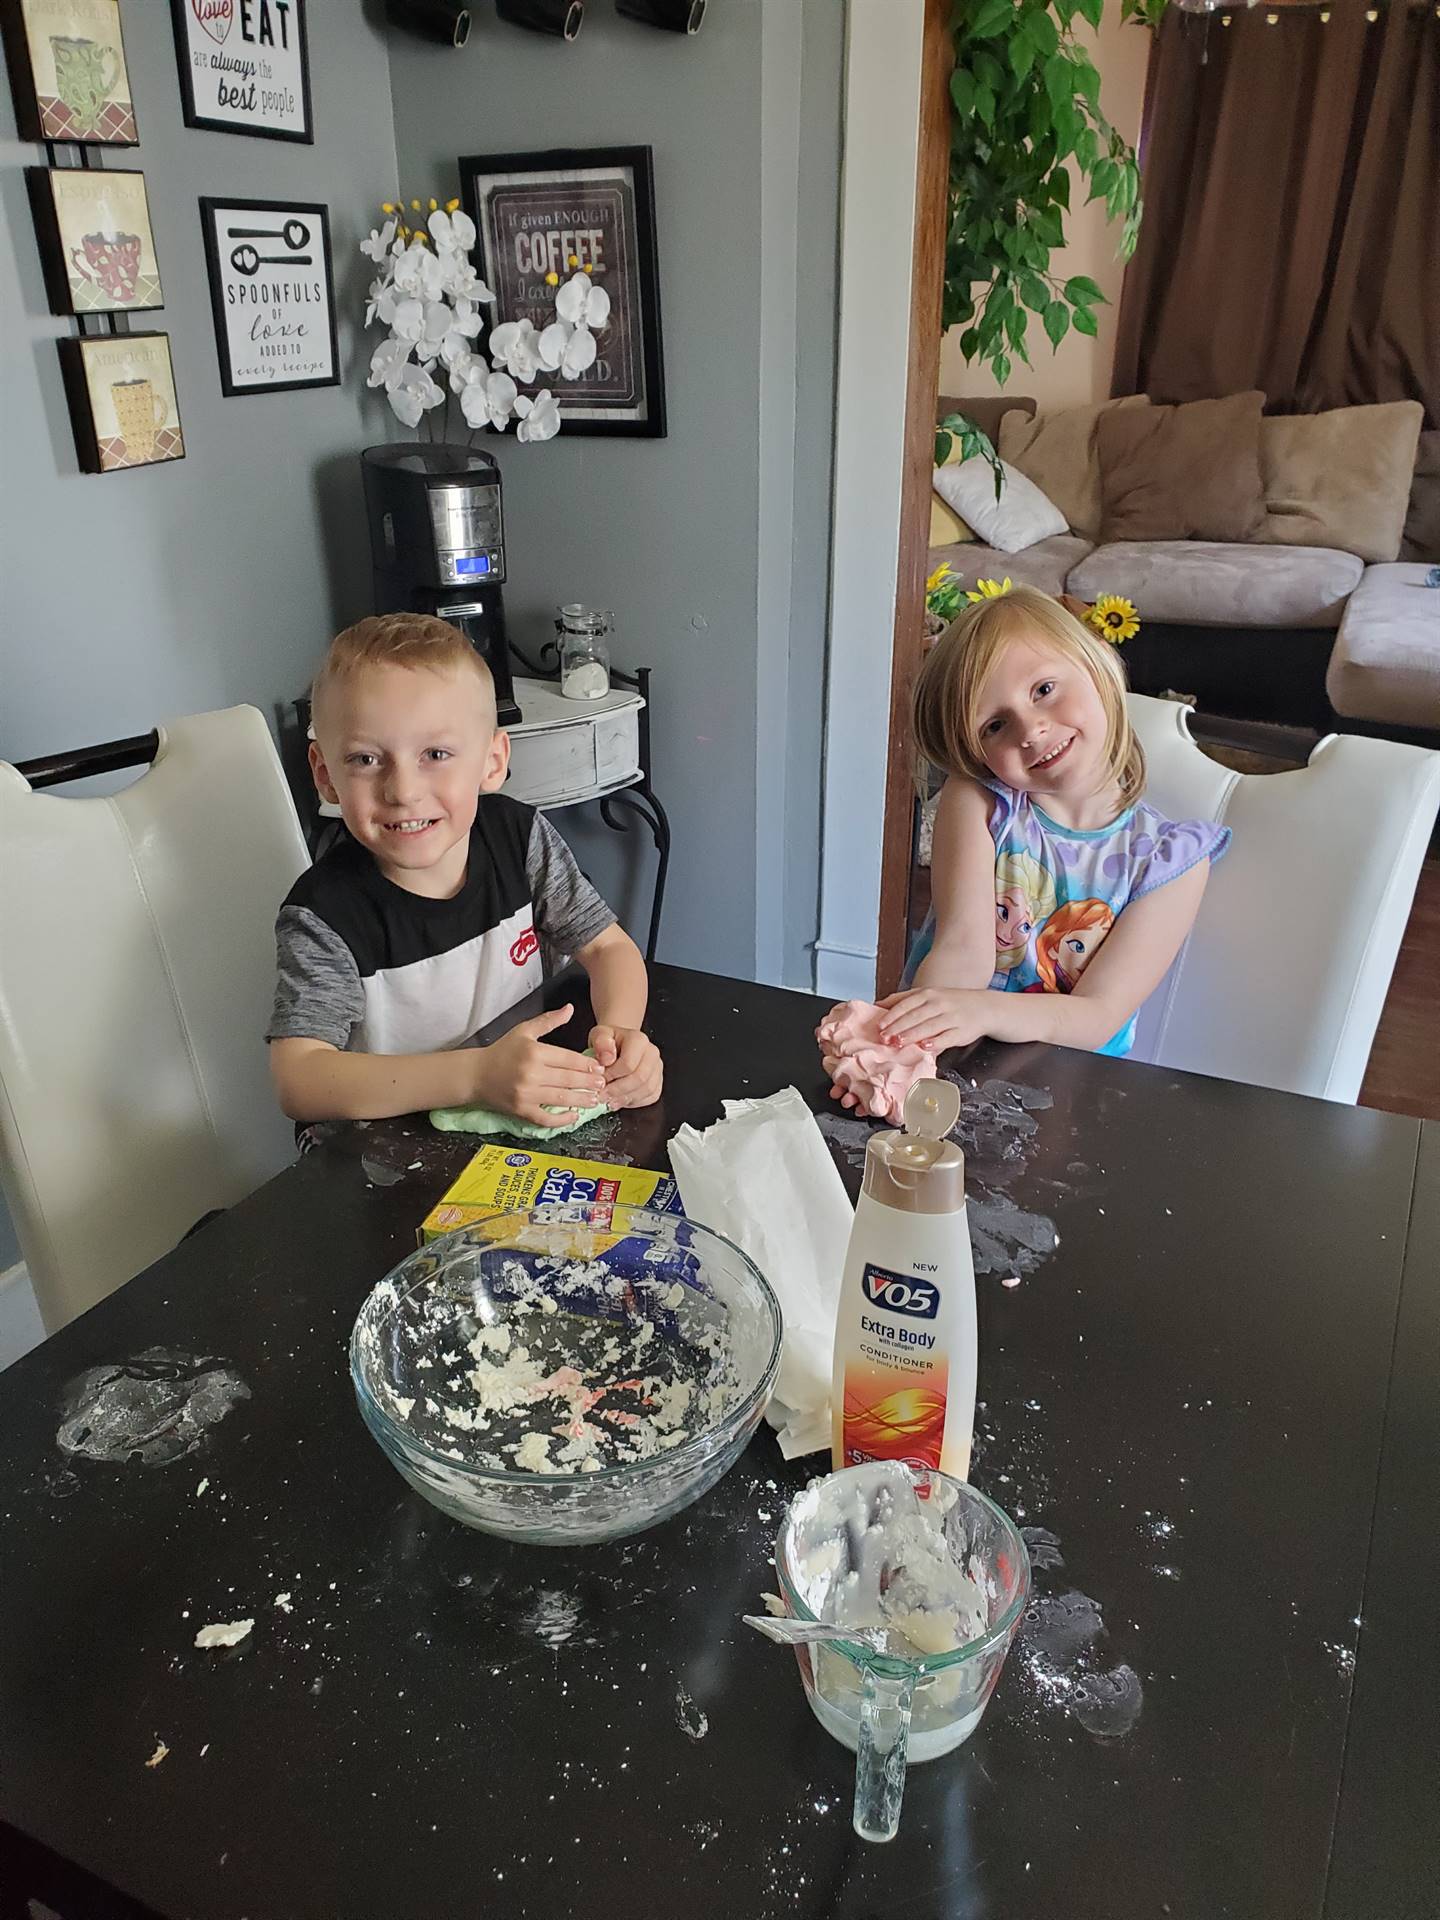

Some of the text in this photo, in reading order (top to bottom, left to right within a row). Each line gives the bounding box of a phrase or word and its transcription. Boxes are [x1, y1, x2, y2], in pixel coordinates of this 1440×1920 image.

[215, 22, 224, 38] to
[240, 0, 289, 49] EAT
[193, 51, 272, 81] are always the
[218, 77, 295, 117] best people
[521, 212, 552, 229] given
[554, 208, 609, 225] ENOUGH
[514, 229, 607, 273] COFFEE
[227, 283, 321, 304] SPOONFULS
[272, 308, 282, 320] OF
[248, 314, 309, 341] love
[260, 344, 301, 357] ADDED TO
[237, 360, 326, 379] every recipe
[491, 1174, 511, 1208] AND SOUPS
[507, 1169, 525, 1193] SAUCES,
[521, 1168, 538, 1195] THICKENS
[912, 1262, 938, 1273] NEW
[868, 1275, 935, 1311] VO5
[861, 1316, 936, 1349] Extra Body
[878, 1338, 915, 1351] with collagen
[860, 1344, 934, 1369] CONDITIONER
